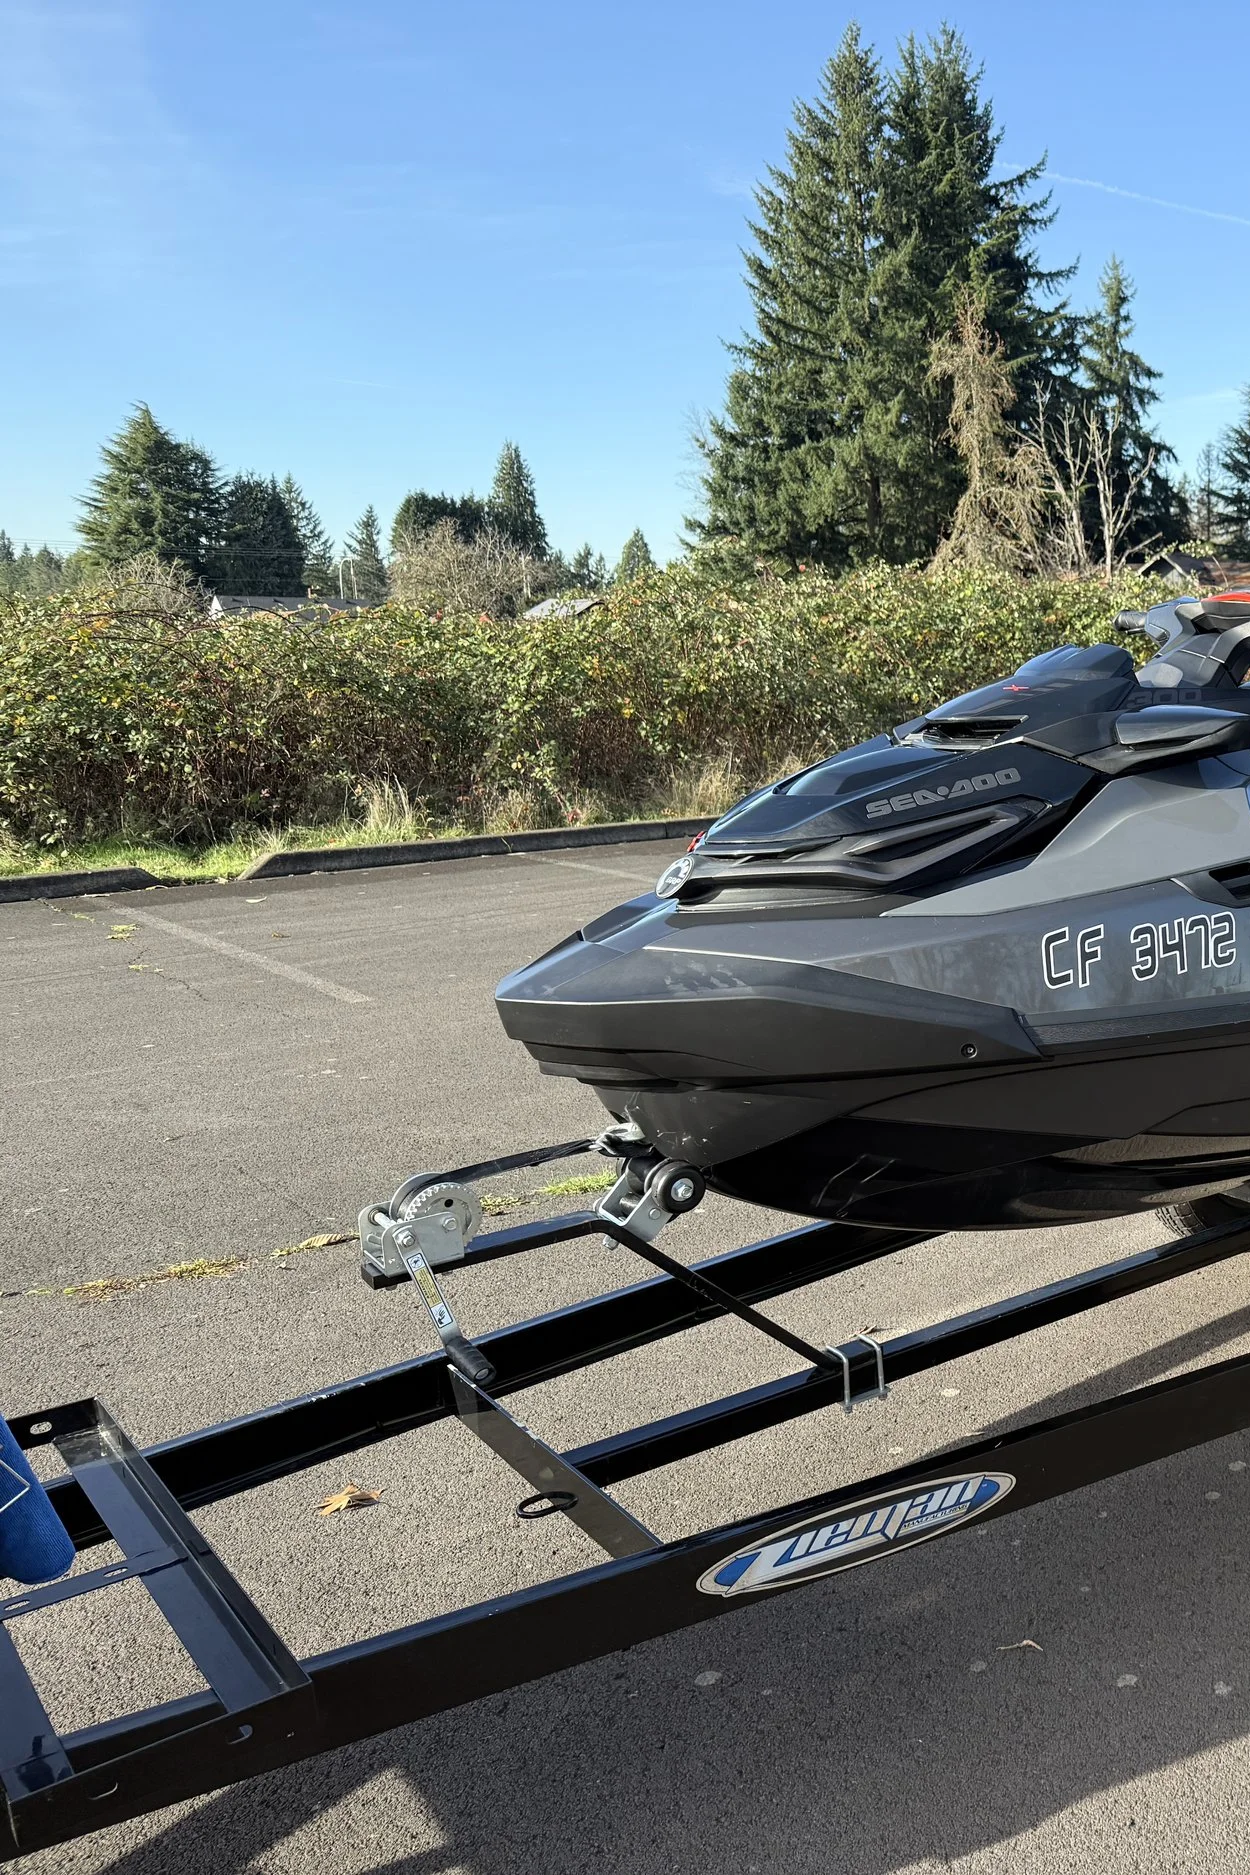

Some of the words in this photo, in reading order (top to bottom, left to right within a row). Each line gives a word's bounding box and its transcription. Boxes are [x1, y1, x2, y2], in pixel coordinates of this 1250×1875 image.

[1041, 923, 1105, 990] CF
[1130, 911, 1237, 982] 3472
[902, 1503, 969, 1530] MANUFACTURING
